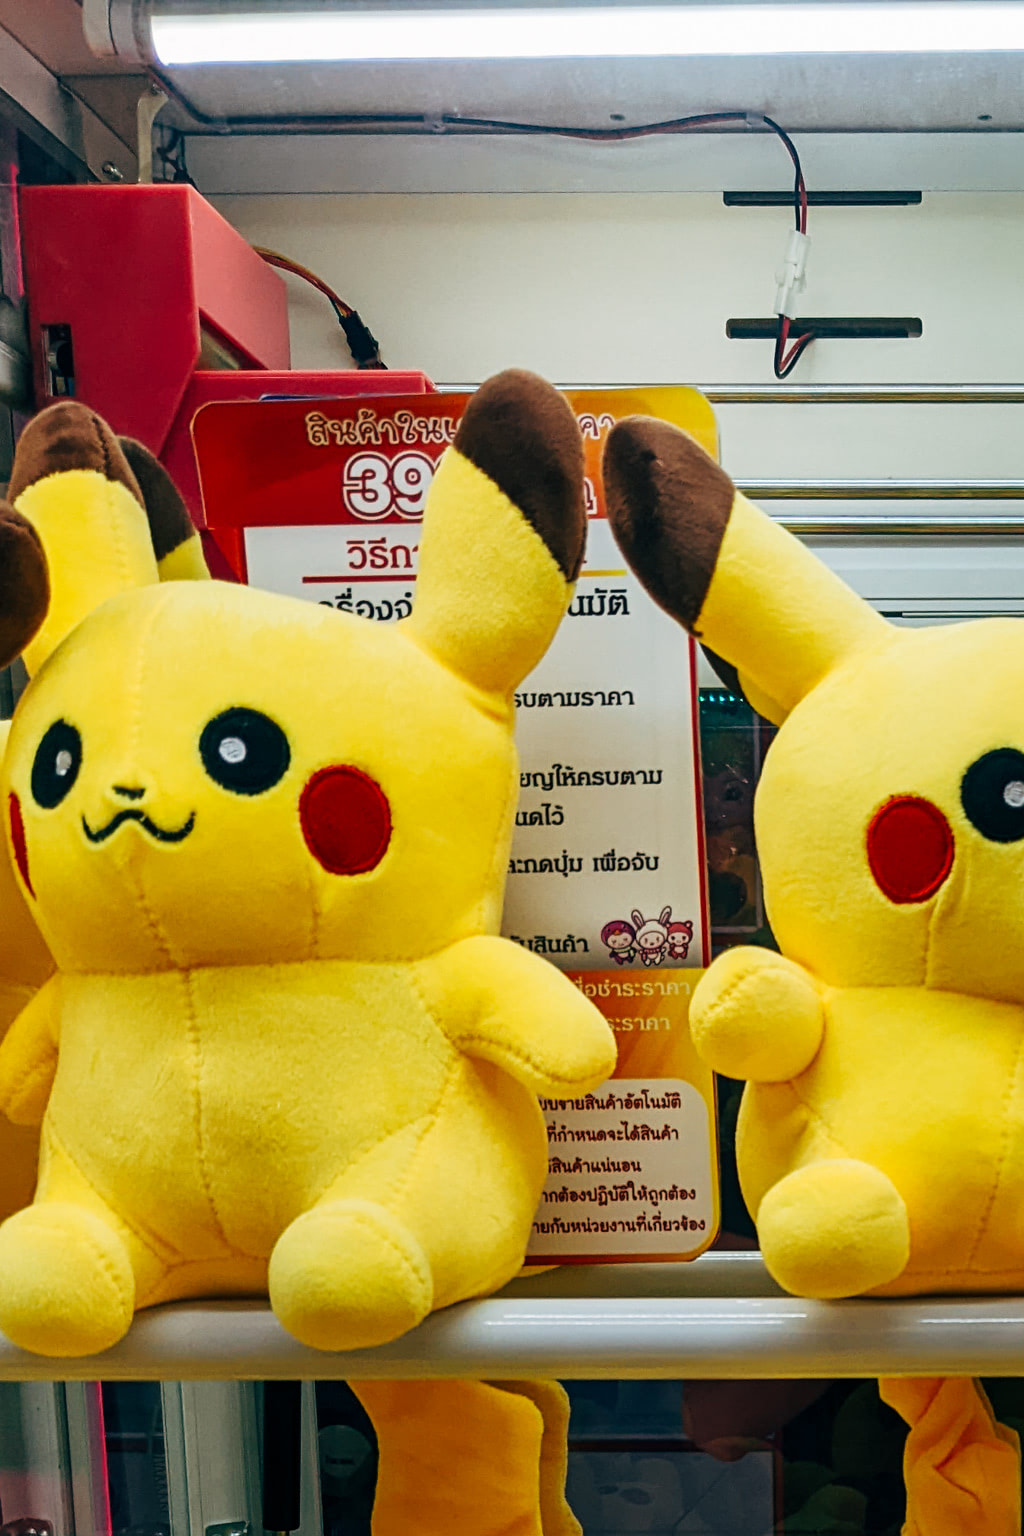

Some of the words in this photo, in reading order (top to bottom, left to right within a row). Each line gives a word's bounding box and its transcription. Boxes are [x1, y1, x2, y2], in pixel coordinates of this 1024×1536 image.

[305, 408, 461, 446] สินค้าในเ
[343, 450, 441, 520] 39
